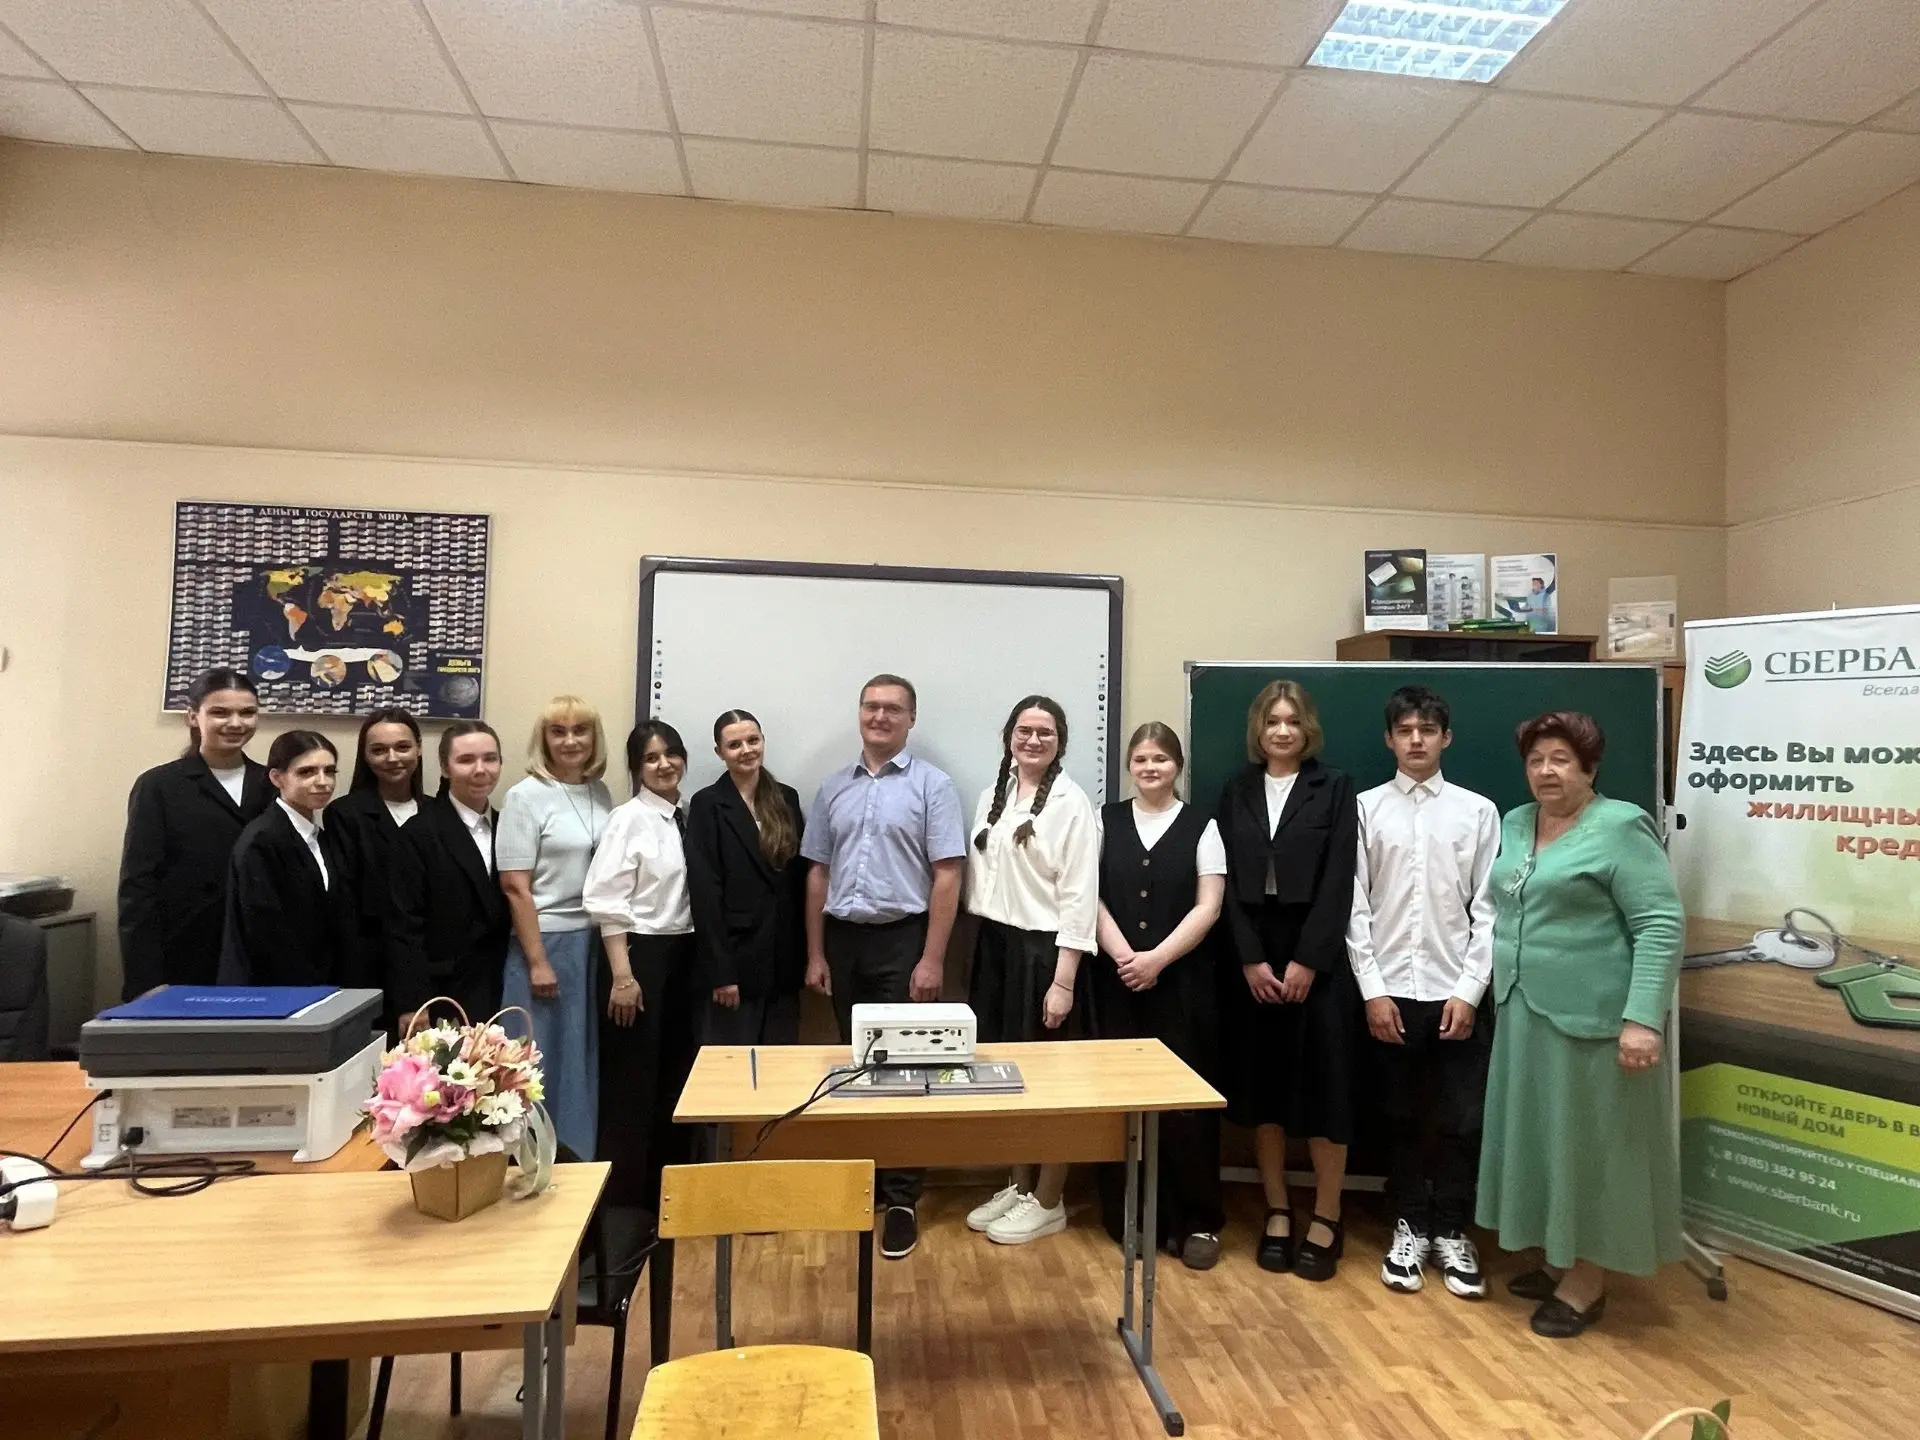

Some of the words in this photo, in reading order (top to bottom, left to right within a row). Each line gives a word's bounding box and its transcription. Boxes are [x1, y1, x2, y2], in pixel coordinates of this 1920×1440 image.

[258, 507, 300, 517] ДЕНЬГИ
[305, 509, 373, 520] ГОСУДАРСТВ
[379, 512, 409, 522] МИРА
[1764, 646, 1920, 675] СБЕРБА
[1862, 684, 1920, 696] Всегда
[1689, 742, 1778, 765] Здесь
[1786, 742, 1834, 763] Вы
[1687, 767, 1854, 795] оформить
[1836, 834, 1920, 860] кред
[1736, 1101, 1799, 1126] НОВЫЙ
[1801, 1117, 1845, 1138] ДОМ
[1737, 1084, 1828, 1115] ОТКРОЙТЕ
[1830, 1106, 1888, 1129] ДВЕРЬ
[1892, 1120, 1904, 1133] В
[1799, 1171, 1817, 1185] 95
[1818, 1176, 1837, 1190] 24
